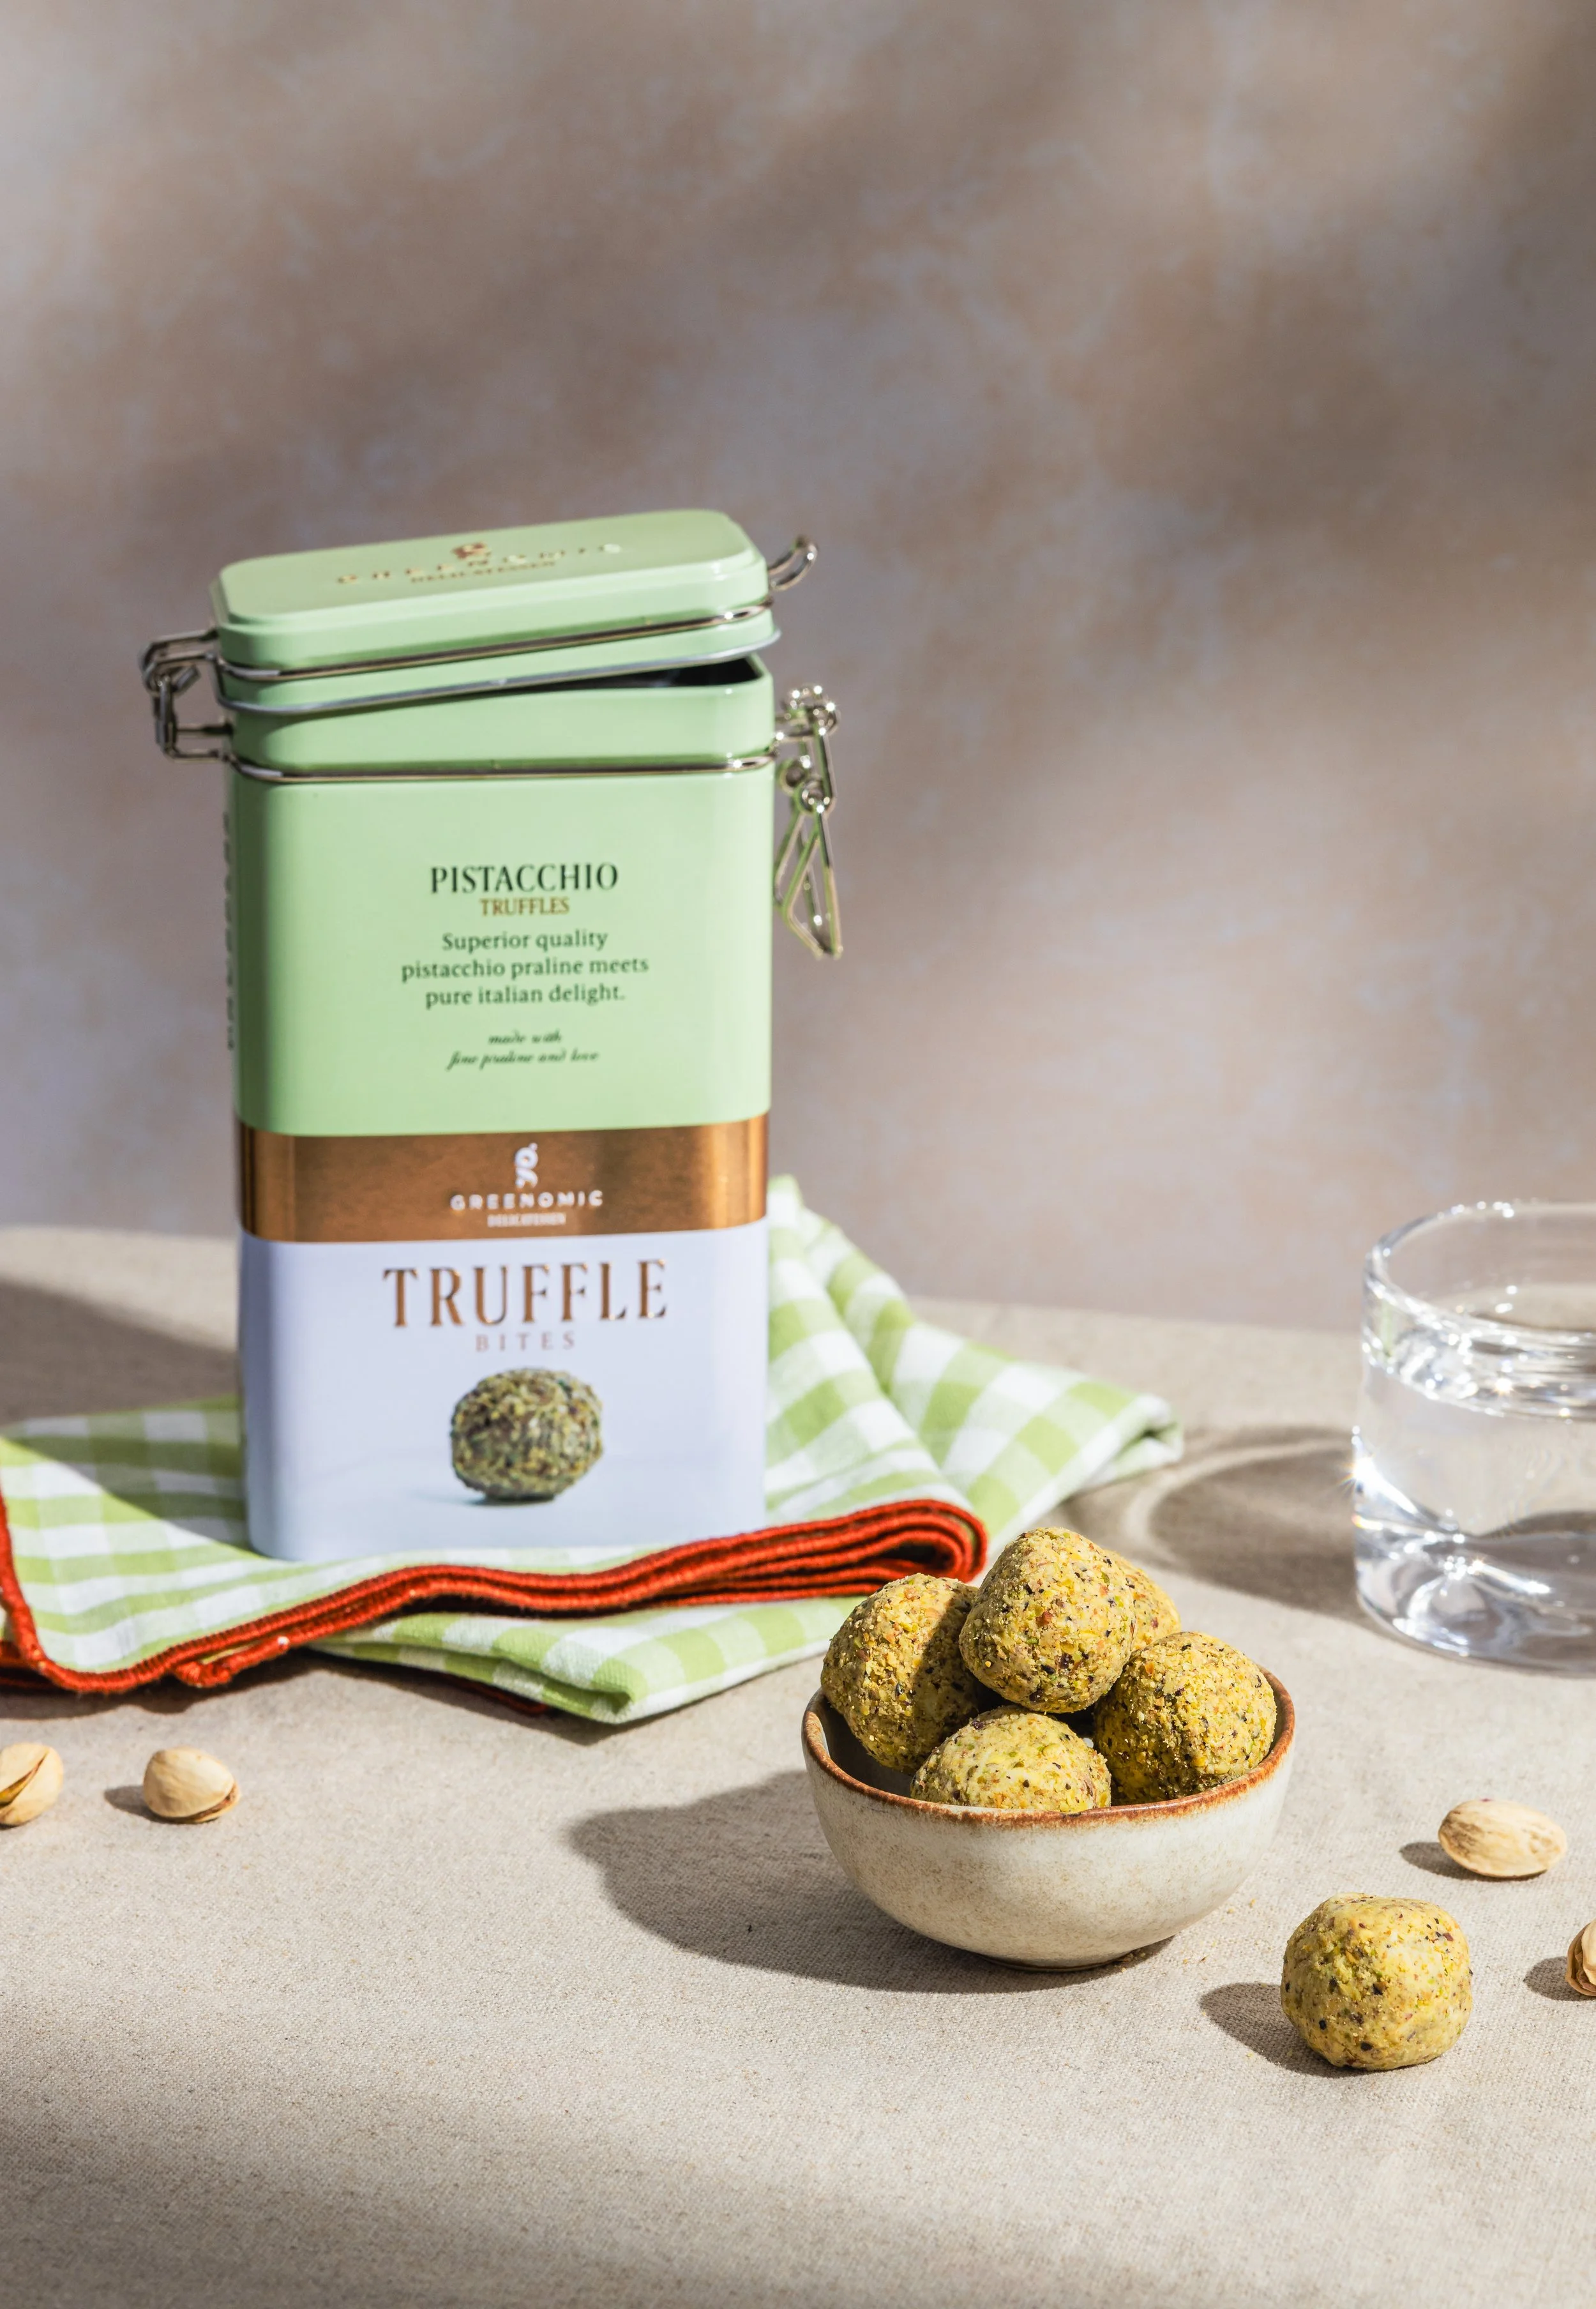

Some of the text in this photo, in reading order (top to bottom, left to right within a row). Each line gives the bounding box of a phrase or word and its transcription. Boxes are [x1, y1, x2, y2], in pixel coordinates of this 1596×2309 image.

[431, 863, 617, 893] PISTACCHIO
[480, 897, 569, 916] TRUFFLES
[442, 929, 608, 953] Superior quality
[402, 957, 649, 982] pistacchio praline meets
[426, 984, 625, 1009] pure italian delight.
[449, 1190, 603, 1211] GREENOMIC
[383, 1259, 668, 1328] TRUFFLE
[476, 1331, 575, 1352] BITES
